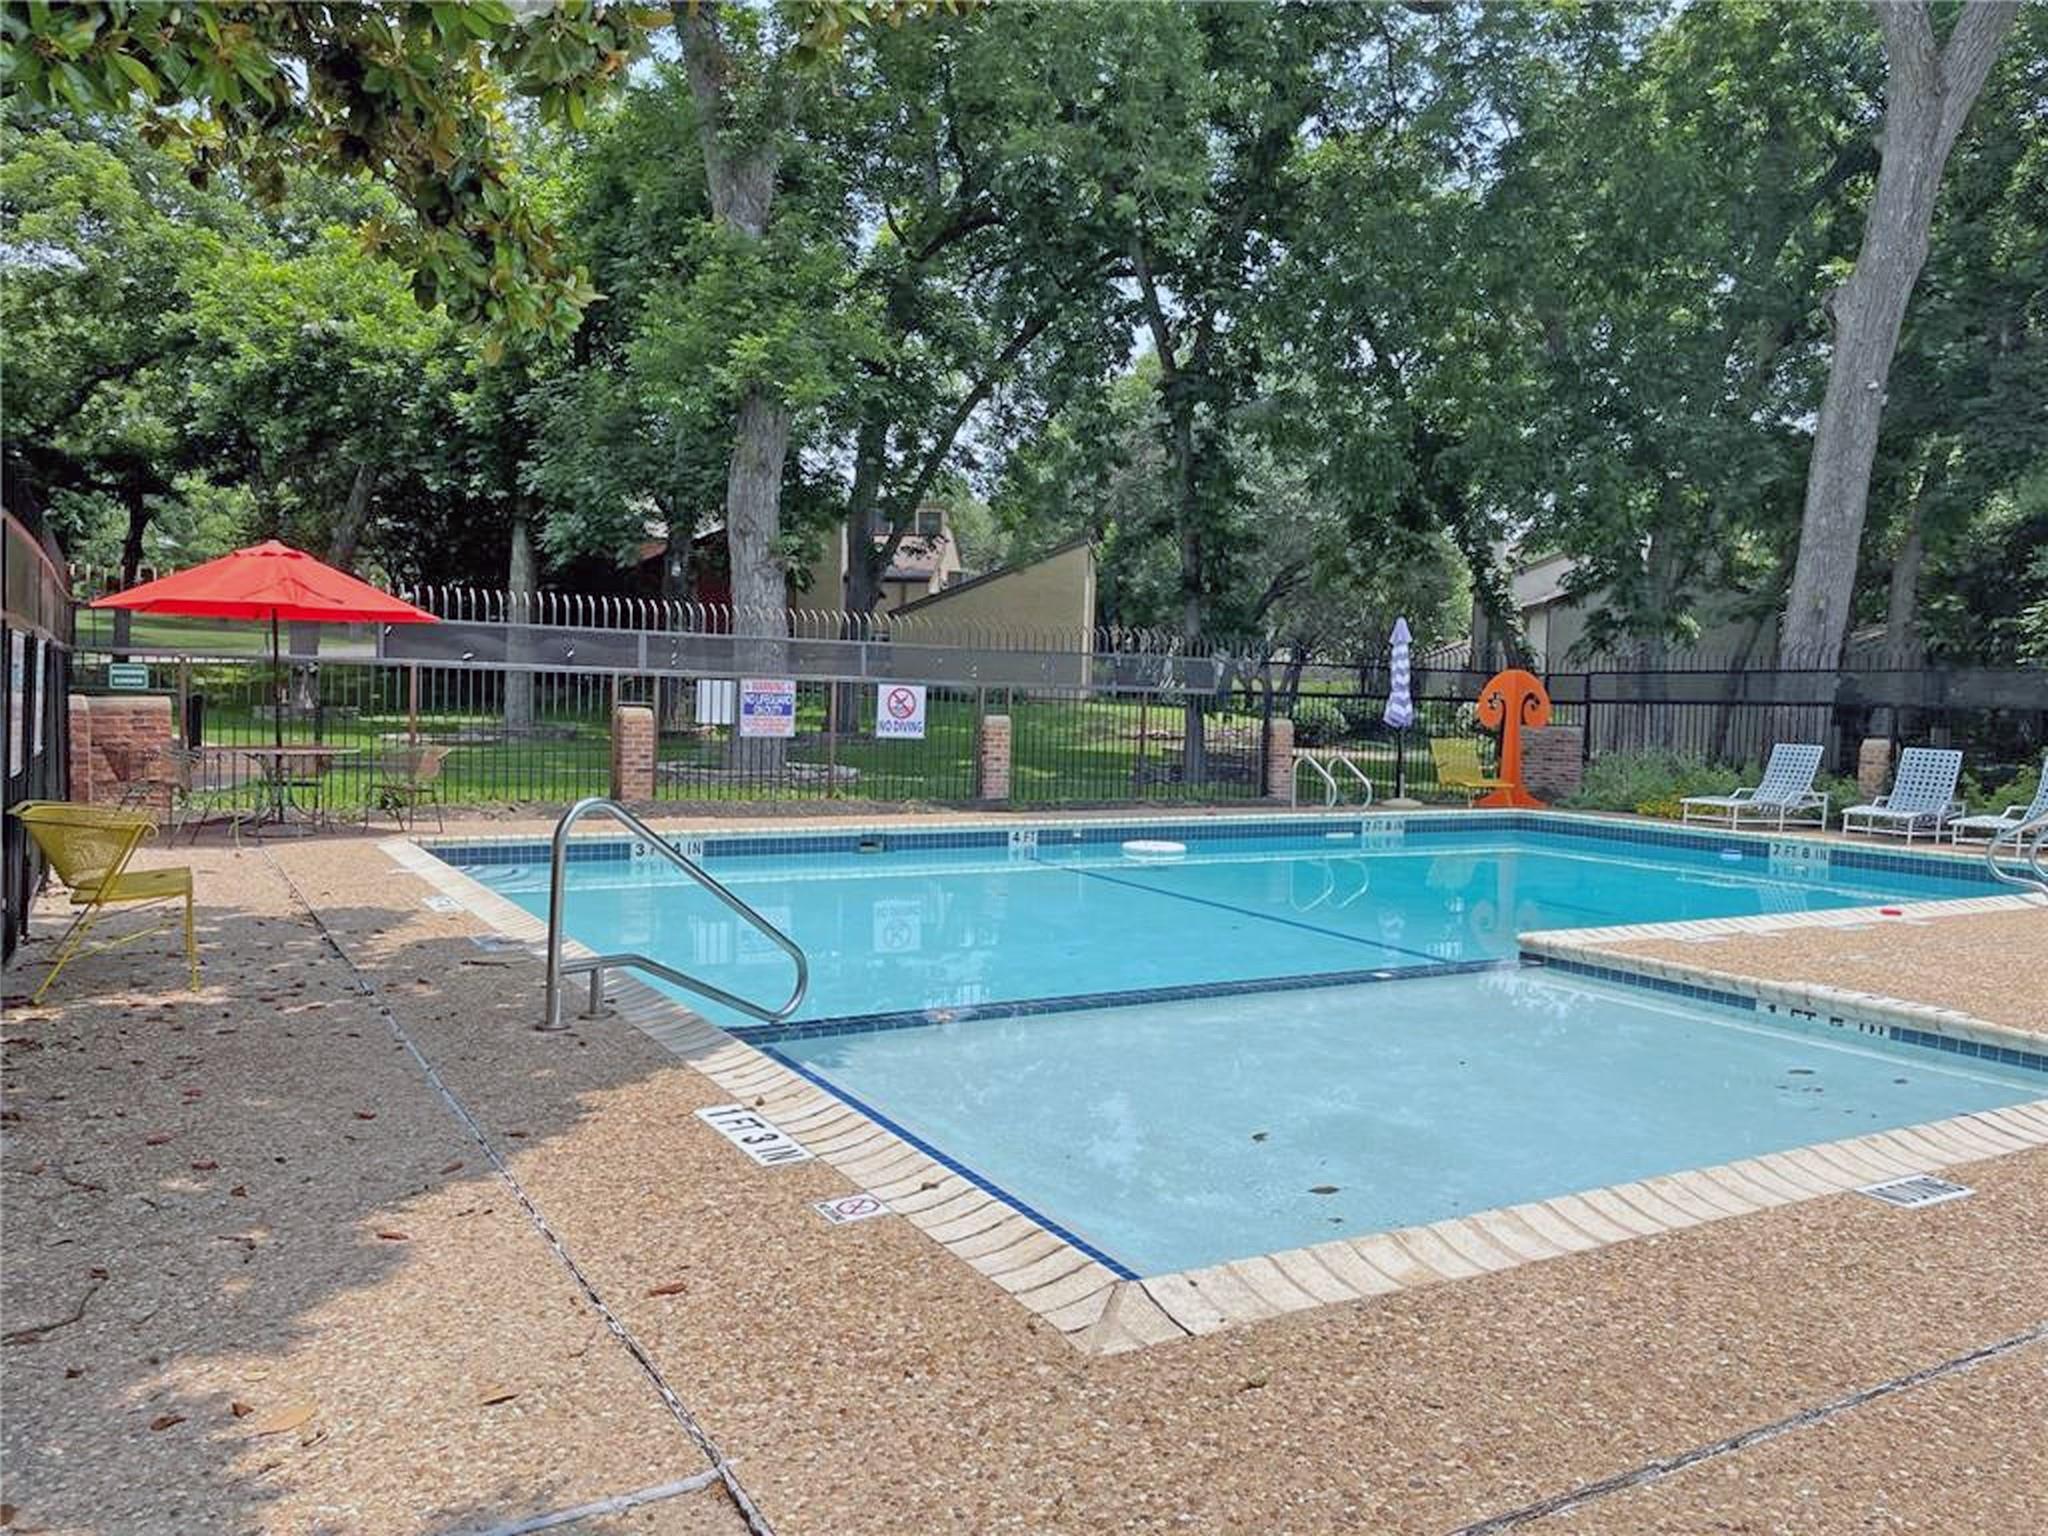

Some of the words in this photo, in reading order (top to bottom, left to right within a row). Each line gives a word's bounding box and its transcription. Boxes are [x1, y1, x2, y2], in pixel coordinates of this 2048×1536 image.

[880, 720, 892, 732] NO
[894, 720, 923, 733] DIVING
[1012, 831, 1020, 842] 4
[635, 843, 645, 857] 3
[687, 841, 701, 855] IN
[1773, 843, 1781, 855] 7
[1784, 845, 1798, 857] FT
[717, 1117, 766, 1132] FT
[741, 1133, 779, 1145] 3
[754, 1145, 805, 1162] IN
